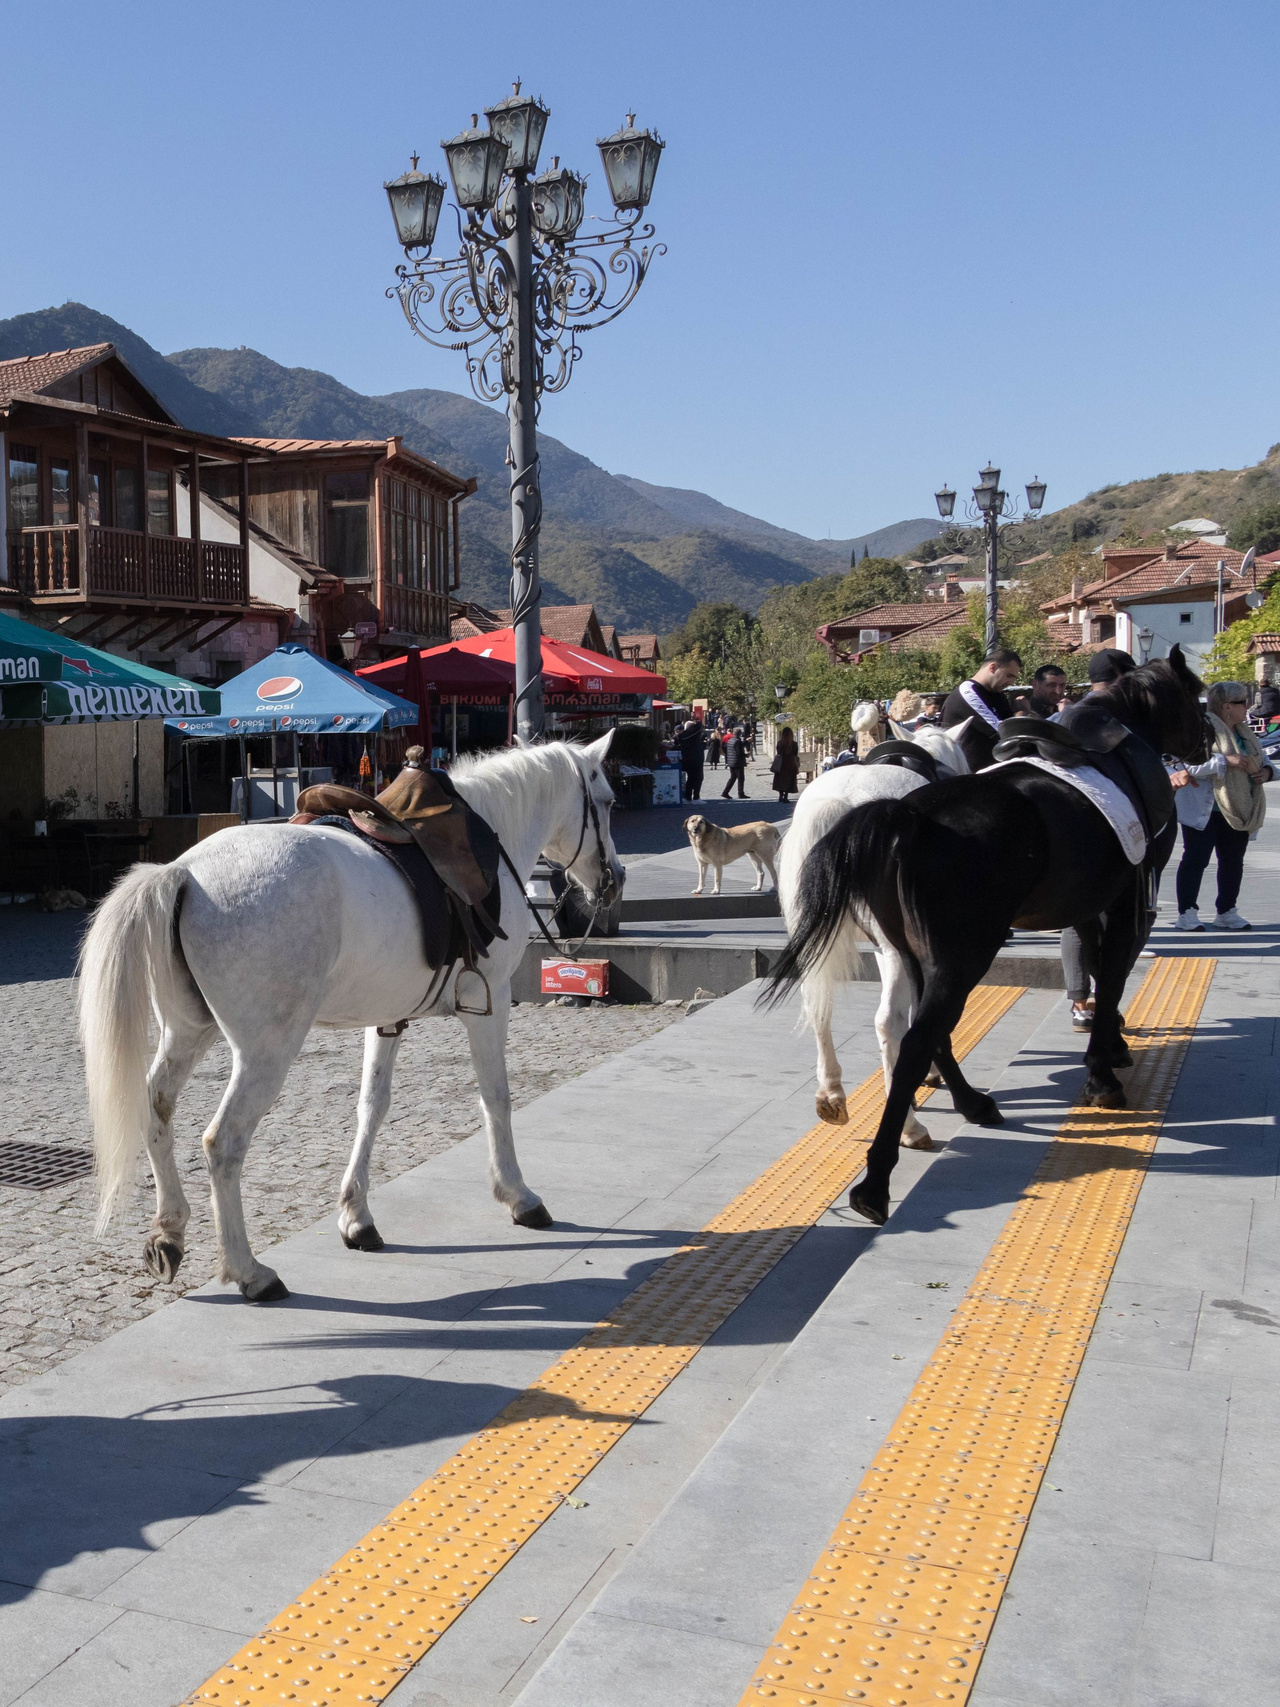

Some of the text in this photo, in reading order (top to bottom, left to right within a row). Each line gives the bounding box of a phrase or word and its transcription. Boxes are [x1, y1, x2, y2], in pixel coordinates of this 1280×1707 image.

[57, 681, 206, 715] Heineken
[255, 702, 294, 712] pepsi
[241, 718, 265, 728] pepsi
[293, 717, 317, 726] pepsi
[345, 716, 370, 725] pepsi
[190, 721, 214, 731] pepsi
